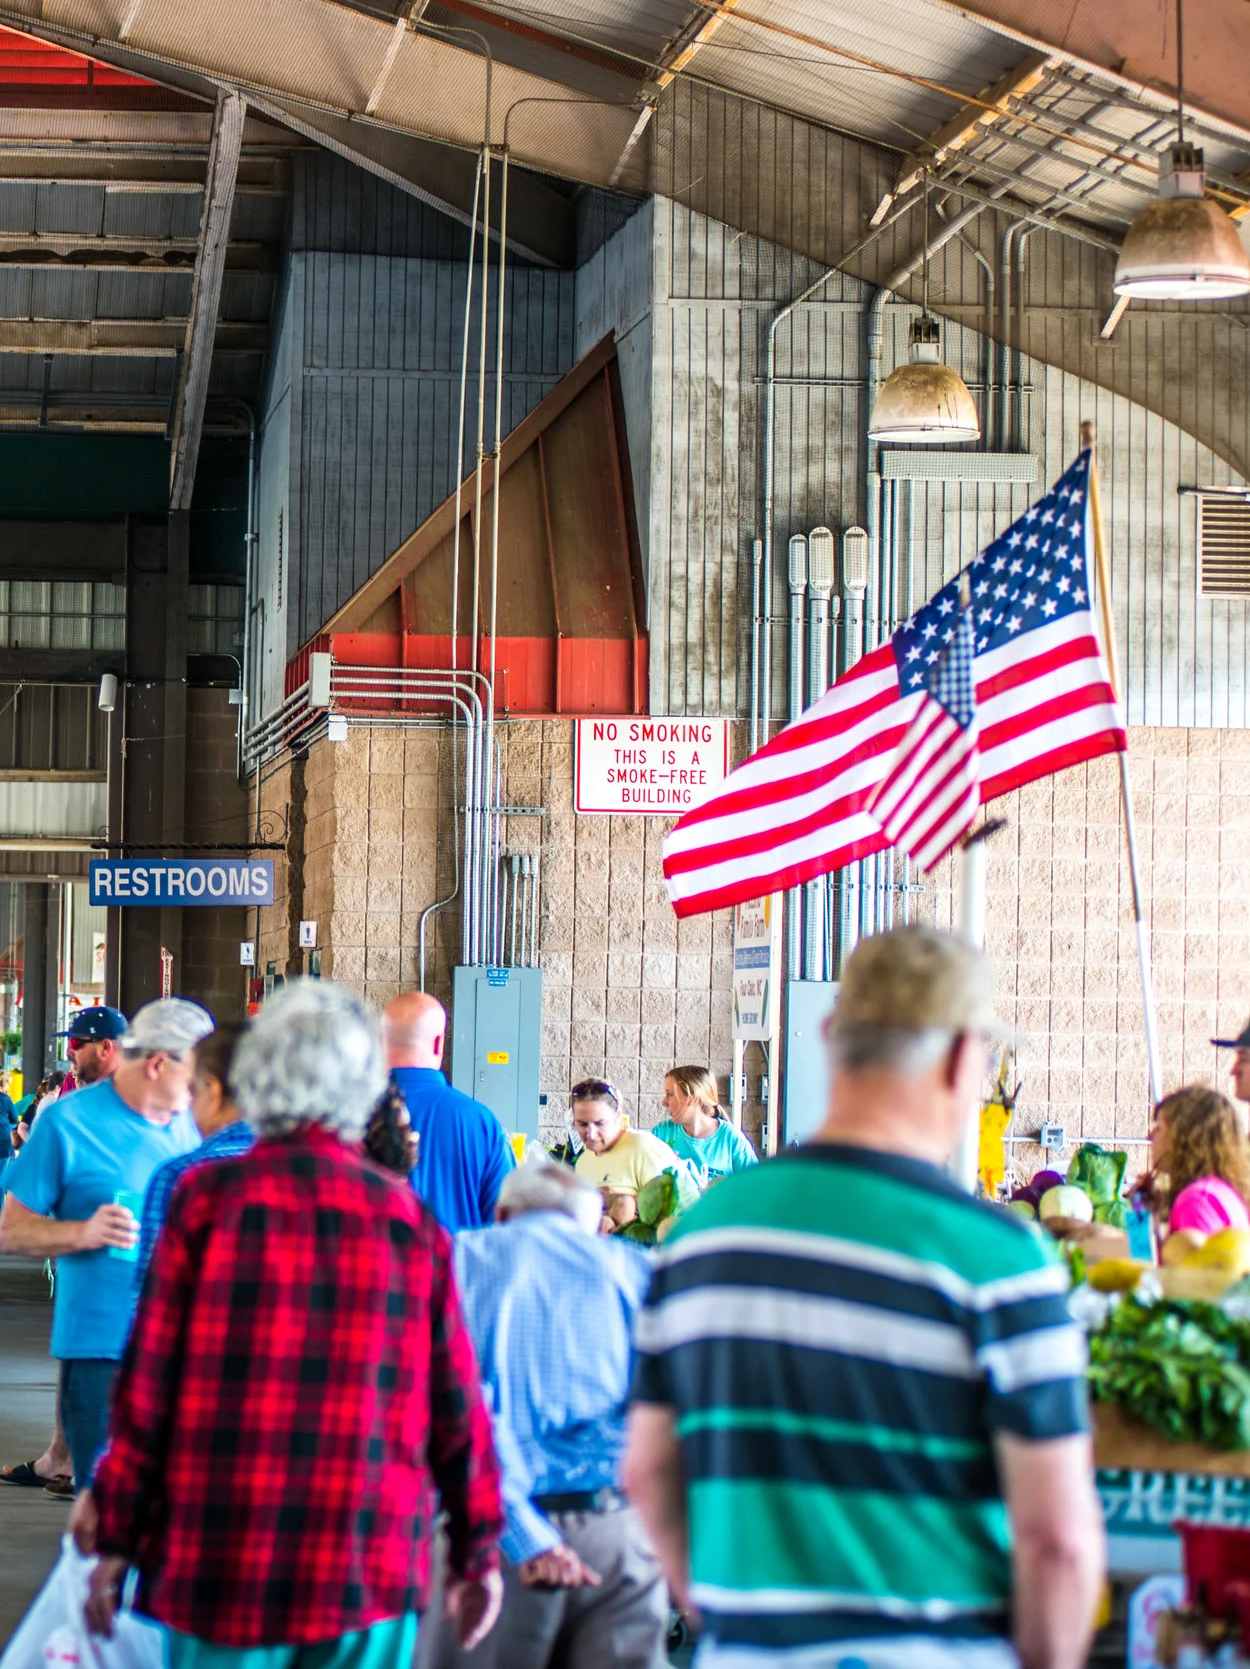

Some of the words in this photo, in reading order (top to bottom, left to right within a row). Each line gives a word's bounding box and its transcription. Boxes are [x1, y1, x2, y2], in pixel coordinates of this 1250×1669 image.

[593, 722, 617, 741] NO
[629, 723, 712, 743] SMOKING
[614, 749, 647, 764] THIS
[662, 750, 676, 765] IS
[691, 751, 700, 765] A
[607, 769, 707, 785] SMOKE-FREE
[622, 788, 692, 804] BUILDING
[94, 867, 269, 897] RESTROOMS
